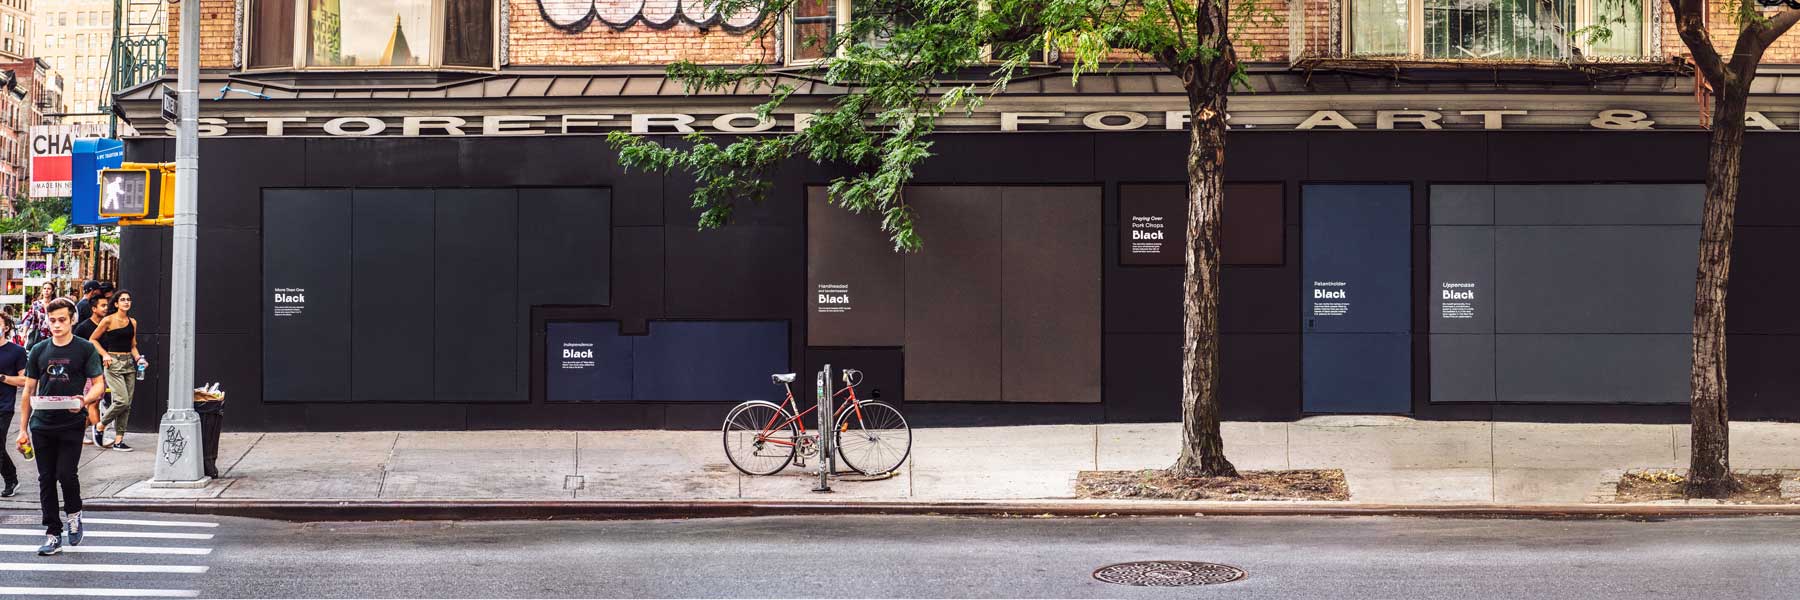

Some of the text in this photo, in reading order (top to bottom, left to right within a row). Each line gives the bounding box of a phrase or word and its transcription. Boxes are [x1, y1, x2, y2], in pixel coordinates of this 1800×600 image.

[1295, 110, 1528, 130] ART
[1590, 110, 1655, 130] &
[1132, 230, 1164, 240] Black
[274, 293, 305, 303] Black
[818, 294, 849, 304] Black
[1314, 289, 1346, 299] Black
[1442, 289, 1474, 299] Black
[563, 348, 593, 358] Black
